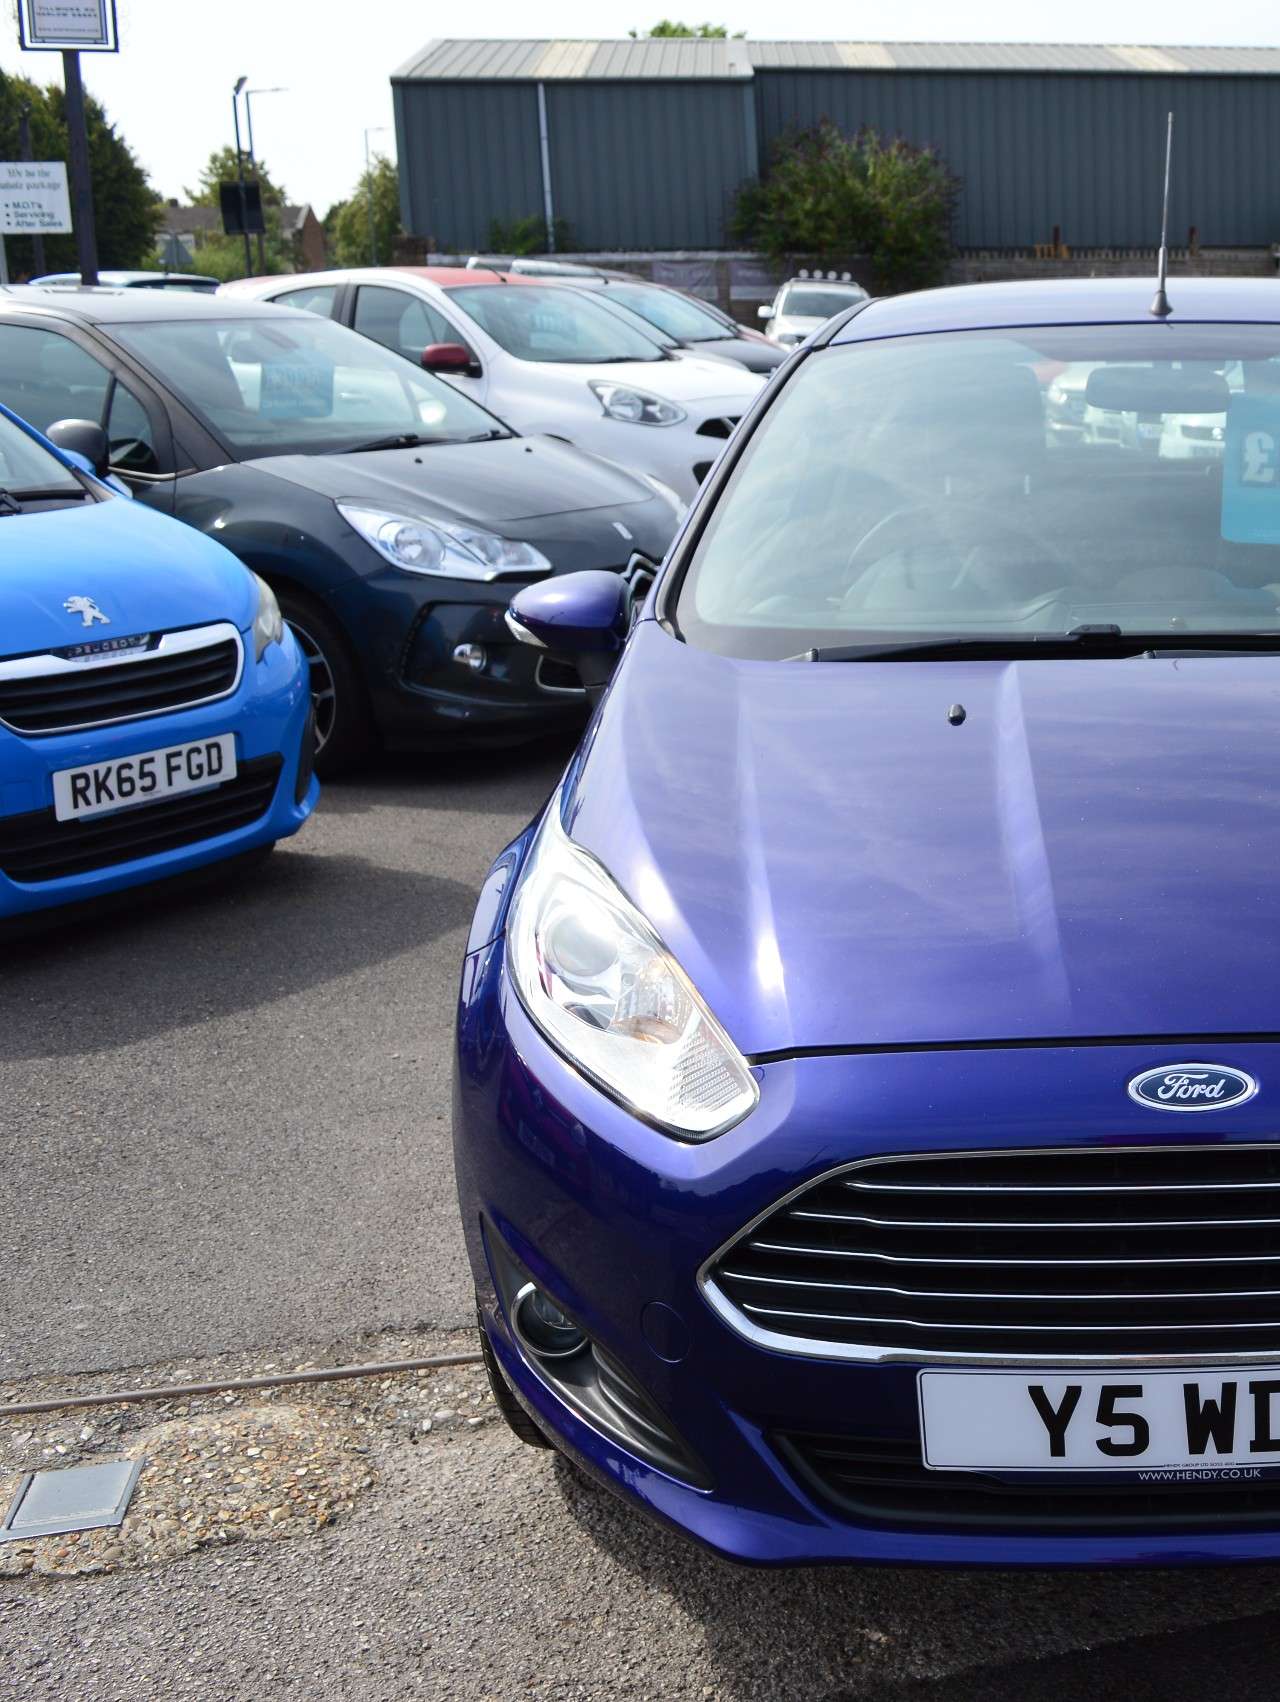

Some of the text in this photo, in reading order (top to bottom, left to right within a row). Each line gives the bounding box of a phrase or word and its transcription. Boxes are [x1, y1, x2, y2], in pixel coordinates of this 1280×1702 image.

[70, 741, 223, 810] RK65 FGD
[1157, 1073, 1226, 1099] Ford
[1027, 1384, 1151, 1457] Y5
[1139, 1468, 1262, 1481] WWW.HENDY.CO.UK
